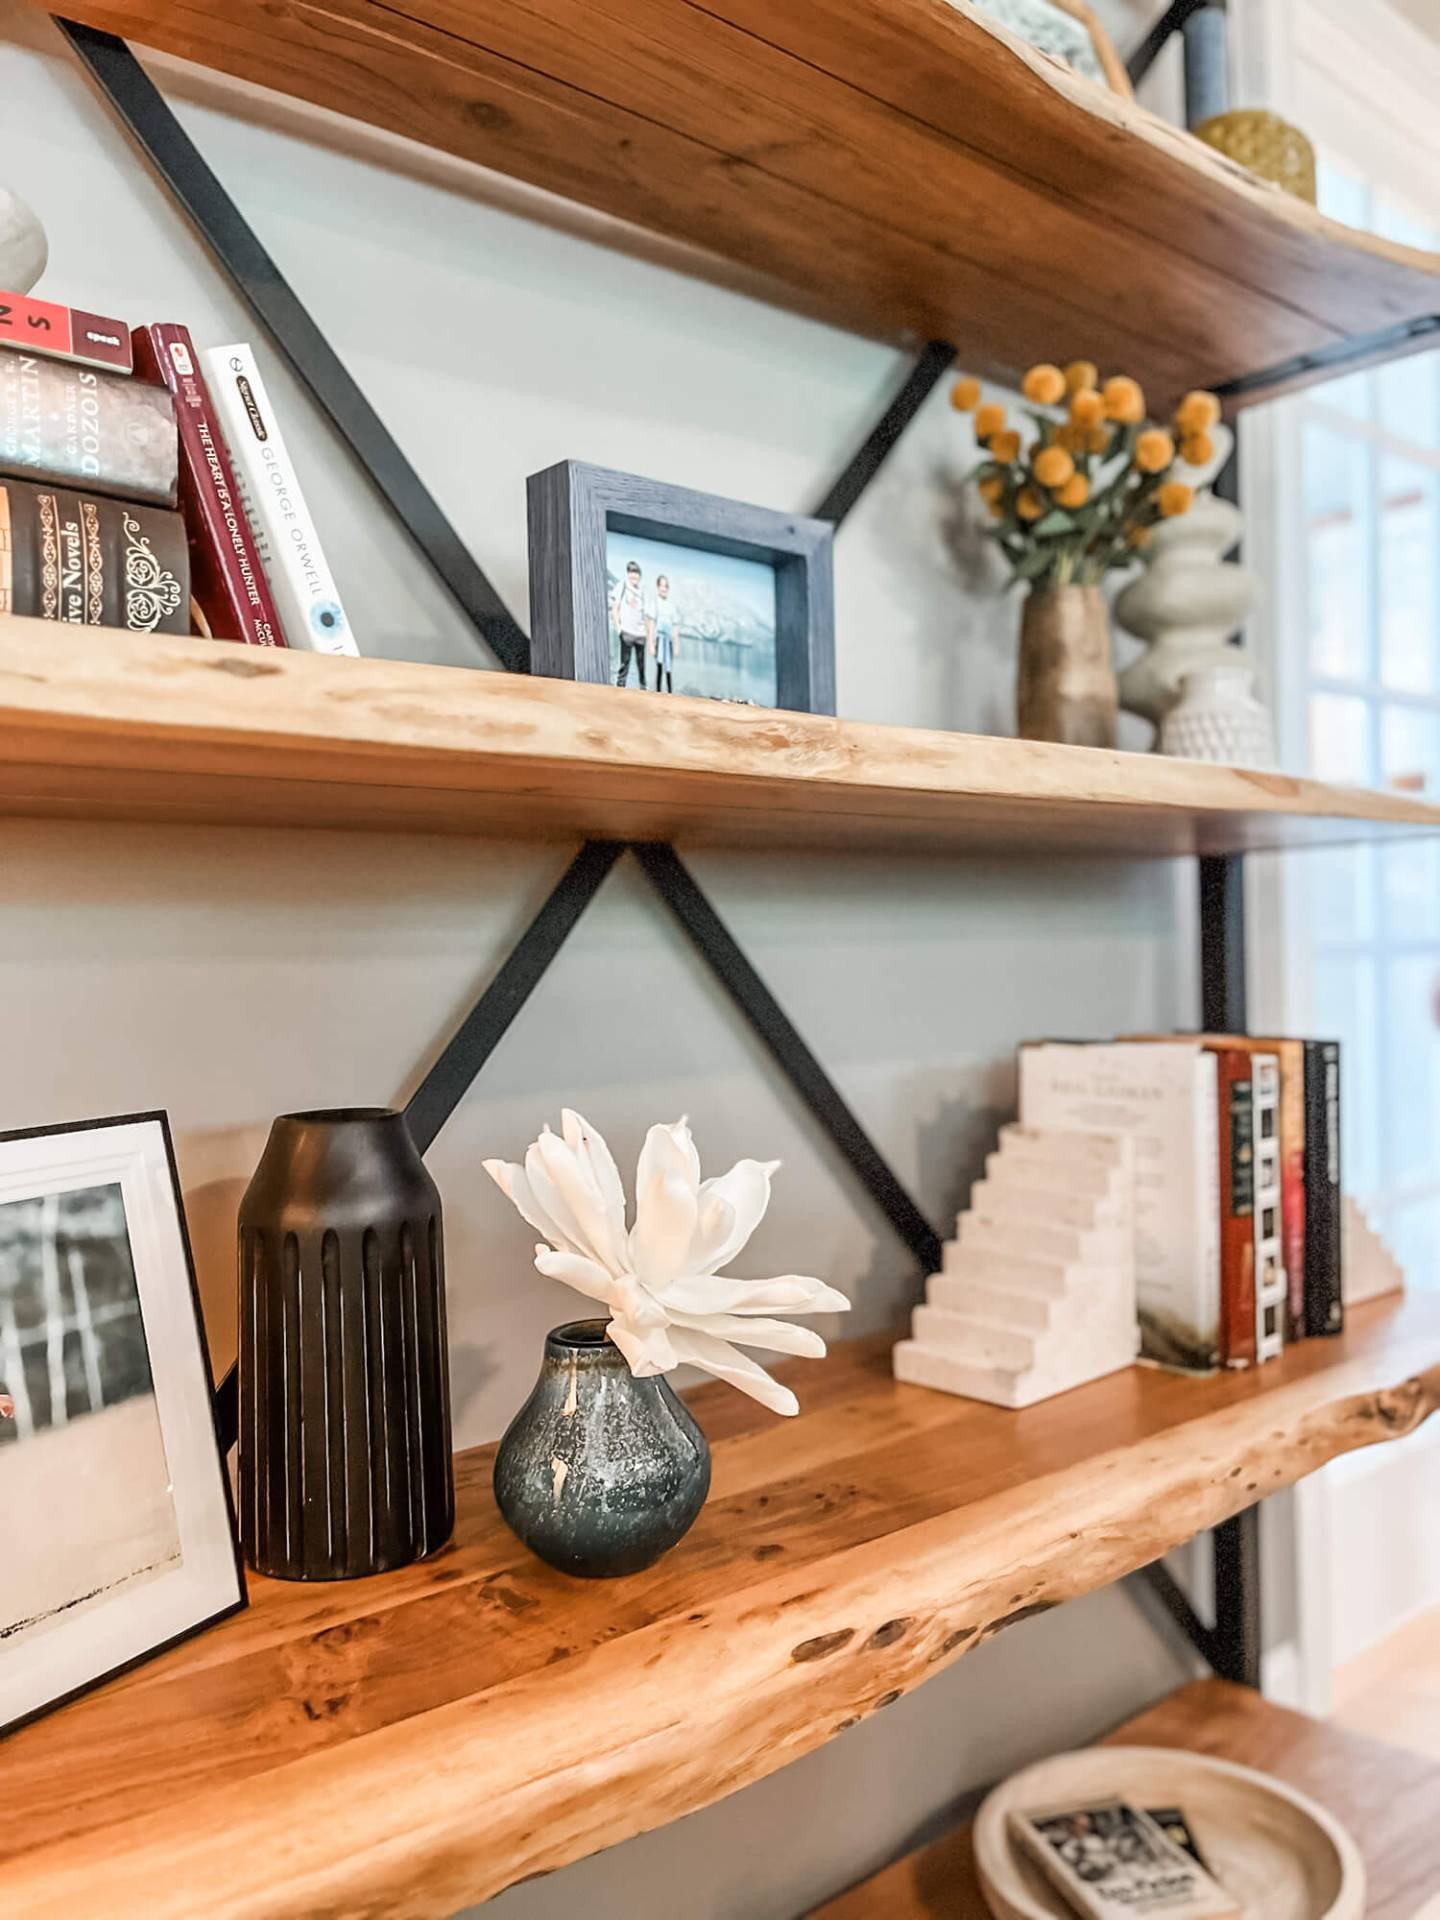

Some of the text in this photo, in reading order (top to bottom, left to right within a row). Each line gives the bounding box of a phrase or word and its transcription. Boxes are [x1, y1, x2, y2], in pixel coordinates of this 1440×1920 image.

[19, 356, 41, 468] MARTIN
[65, 384, 77, 455] GARDNER
[78, 372, 100, 476] DOZOIS
[197, 422, 213, 446] THE
[203, 445, 226, 487] HEART
[223, 511, 247, 558] LONELY
[261, 447, 322, 594] GEORGE ORWELL
[60, 521, 82, 624] ive Novels
[237, 558, 261, 606] HUNTER
